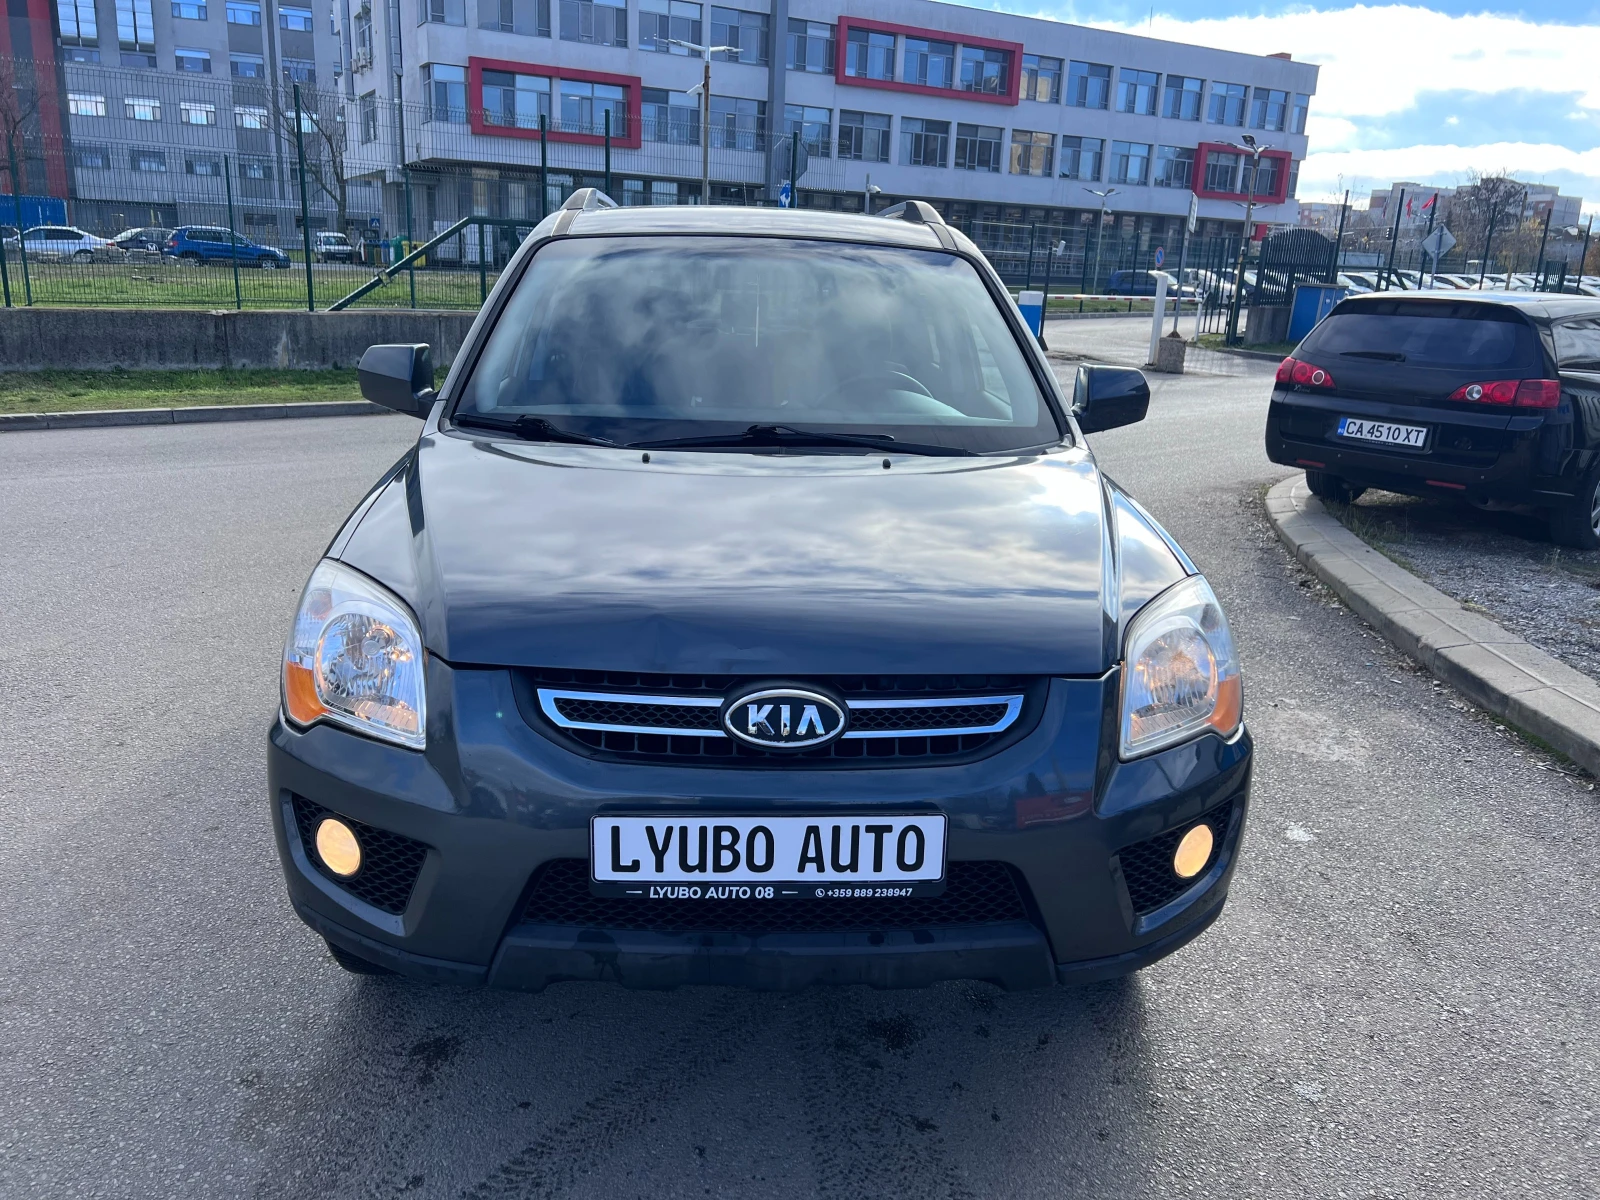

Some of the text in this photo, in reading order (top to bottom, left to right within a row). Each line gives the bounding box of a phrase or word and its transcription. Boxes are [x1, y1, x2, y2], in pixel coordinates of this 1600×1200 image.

[1346, 421, 1364, 436] CA
[1367, 424, 1401, 441] 4510
[1402, 427, 1424, 444] XT
[746, 704, 826, 736] KIA
[610, 824, 926, 873] LYUBO AUTO
[649, 886, 774, 899] LYUBO AUTO 08
[827, 887, 913, 897] +359 889 238947
